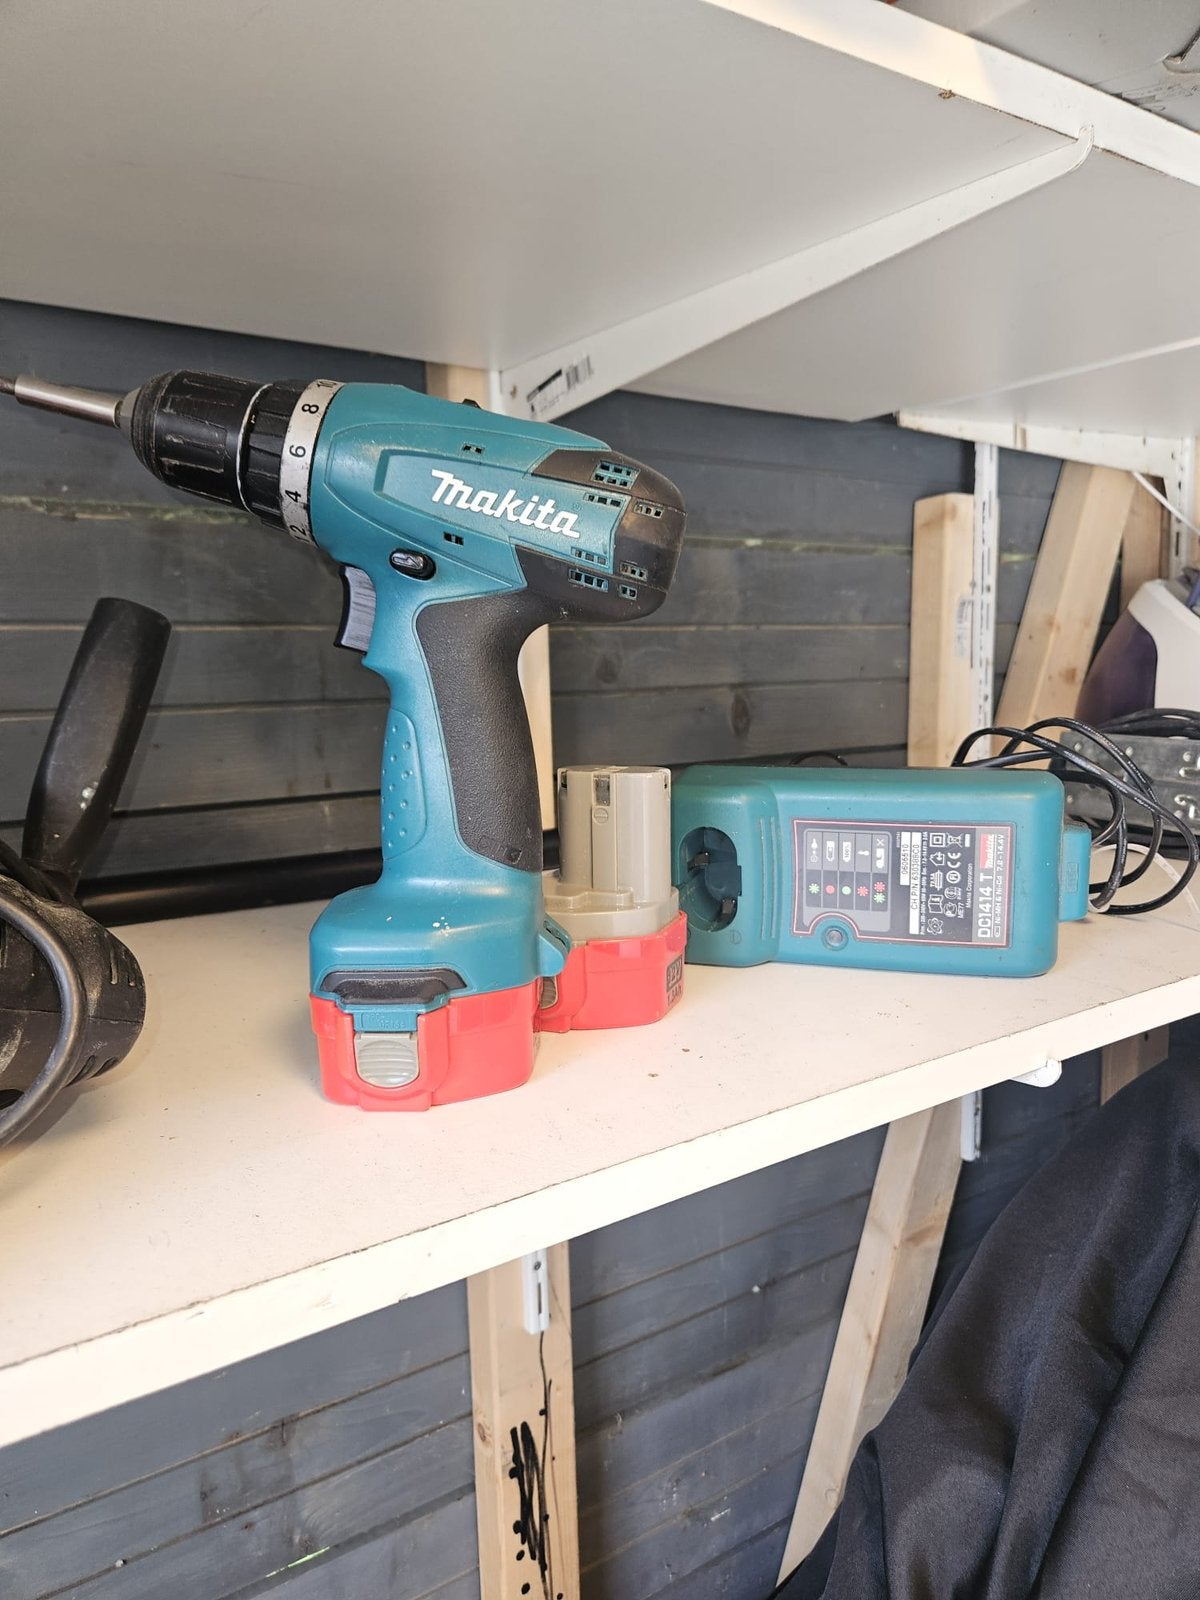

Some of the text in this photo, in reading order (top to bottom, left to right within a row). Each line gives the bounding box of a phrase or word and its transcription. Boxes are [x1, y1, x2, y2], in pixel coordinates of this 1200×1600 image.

[301, 403, 319, 415] 8
[289, 444, 306, 458] 6
[285, 489, 301, 503] 4
[978, 873, 993, 937] DC1414 T
